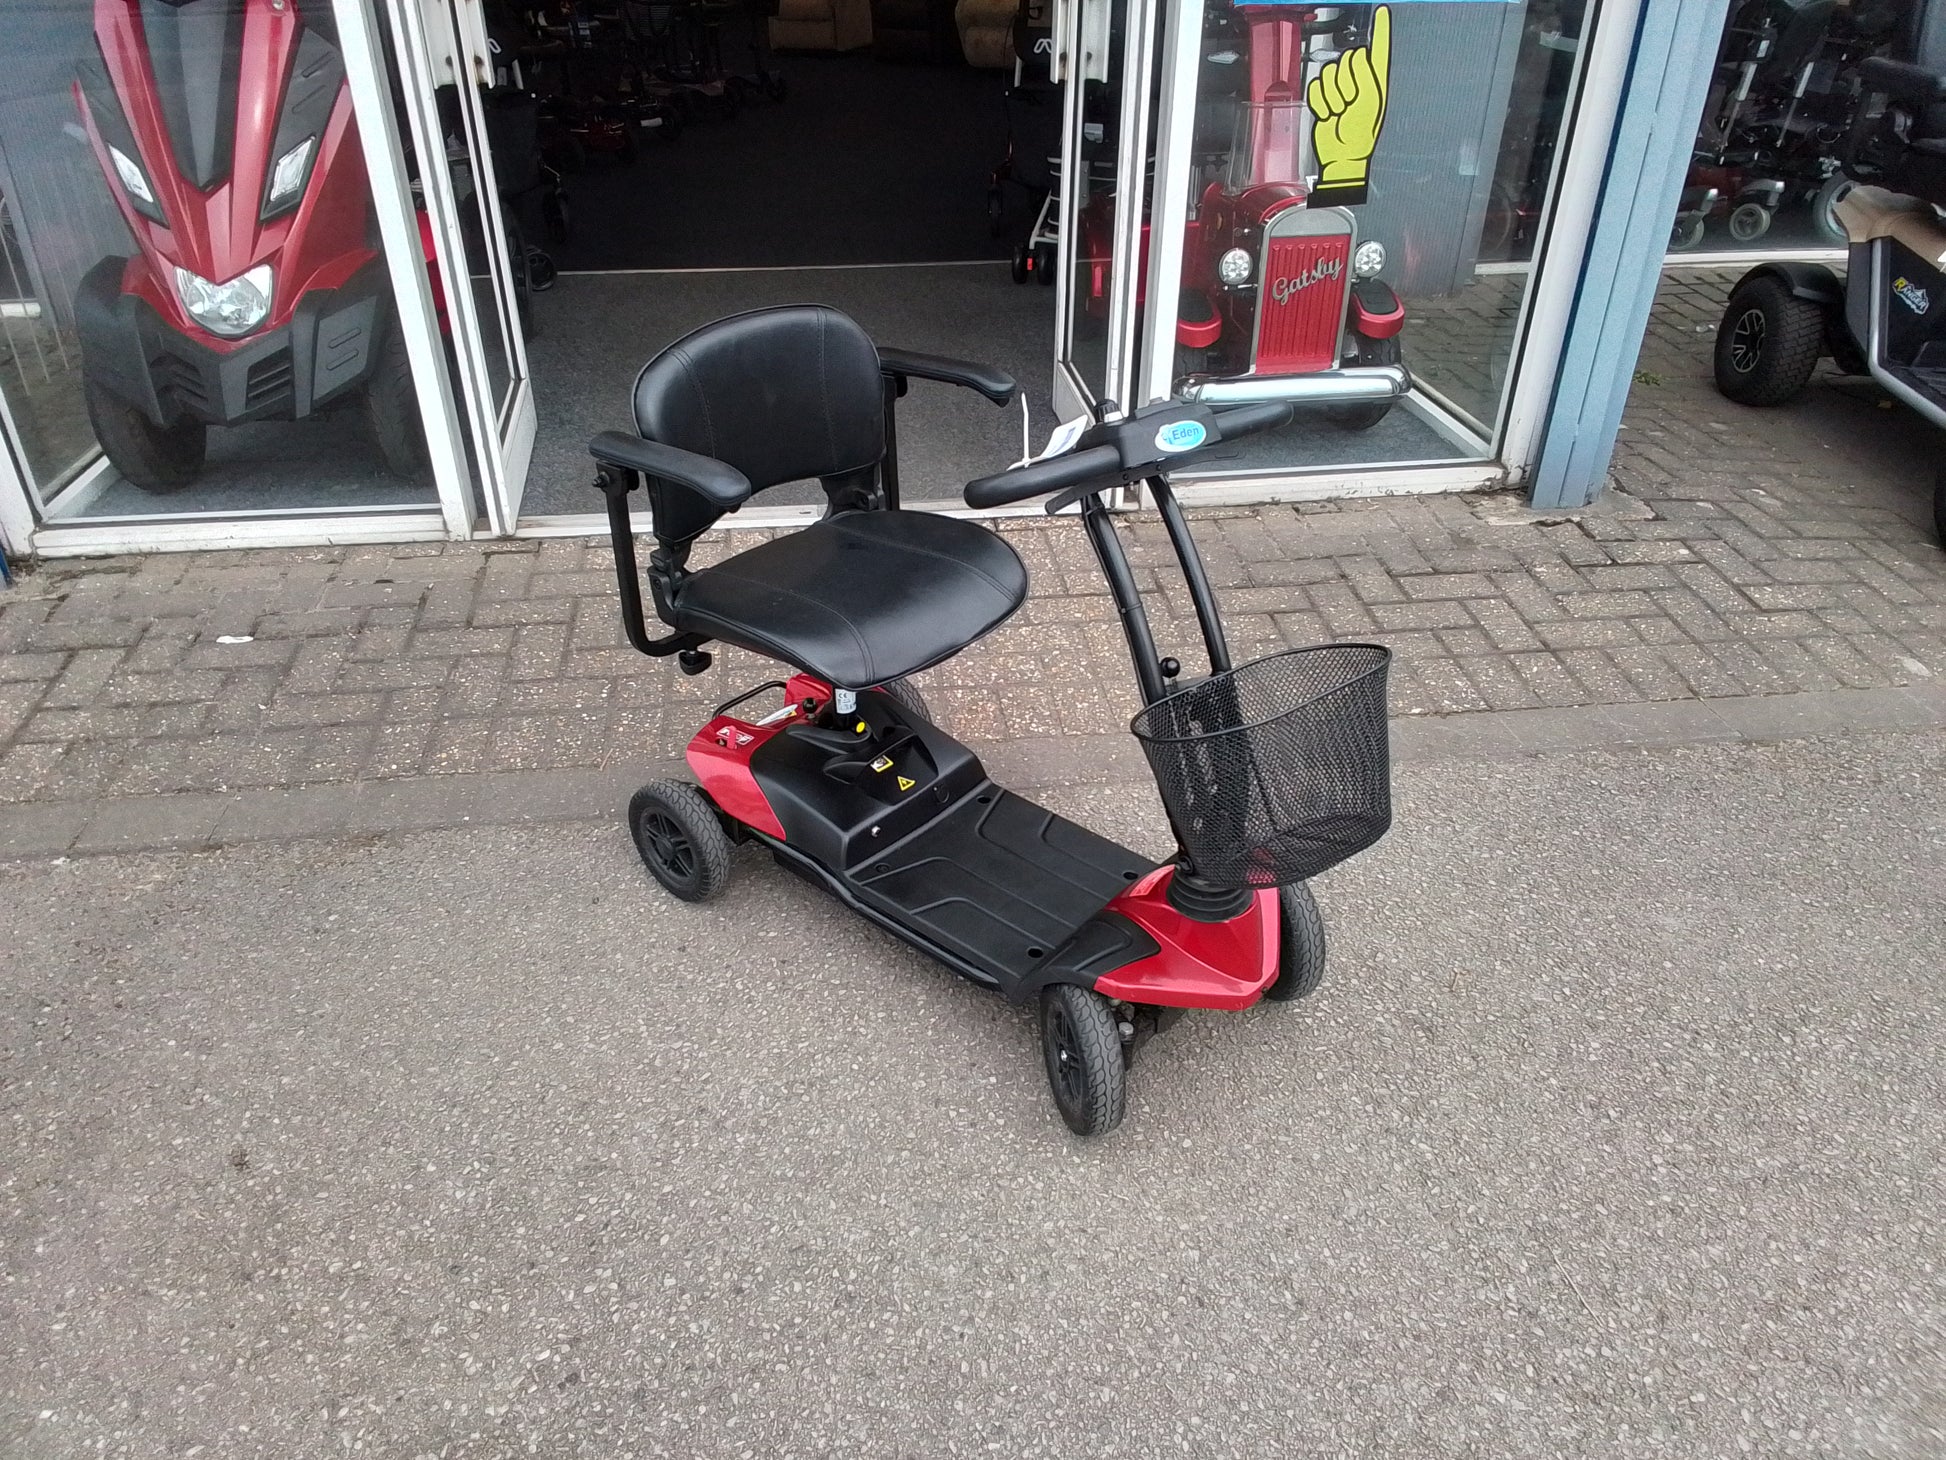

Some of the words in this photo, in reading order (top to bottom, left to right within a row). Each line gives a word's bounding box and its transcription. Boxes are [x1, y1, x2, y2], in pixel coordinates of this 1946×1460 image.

[1272, 256, 1344, 306] Gatsby
[1893, 278, 1927, 310] RANGER
[1171, 427, 1200, 441] Eden
